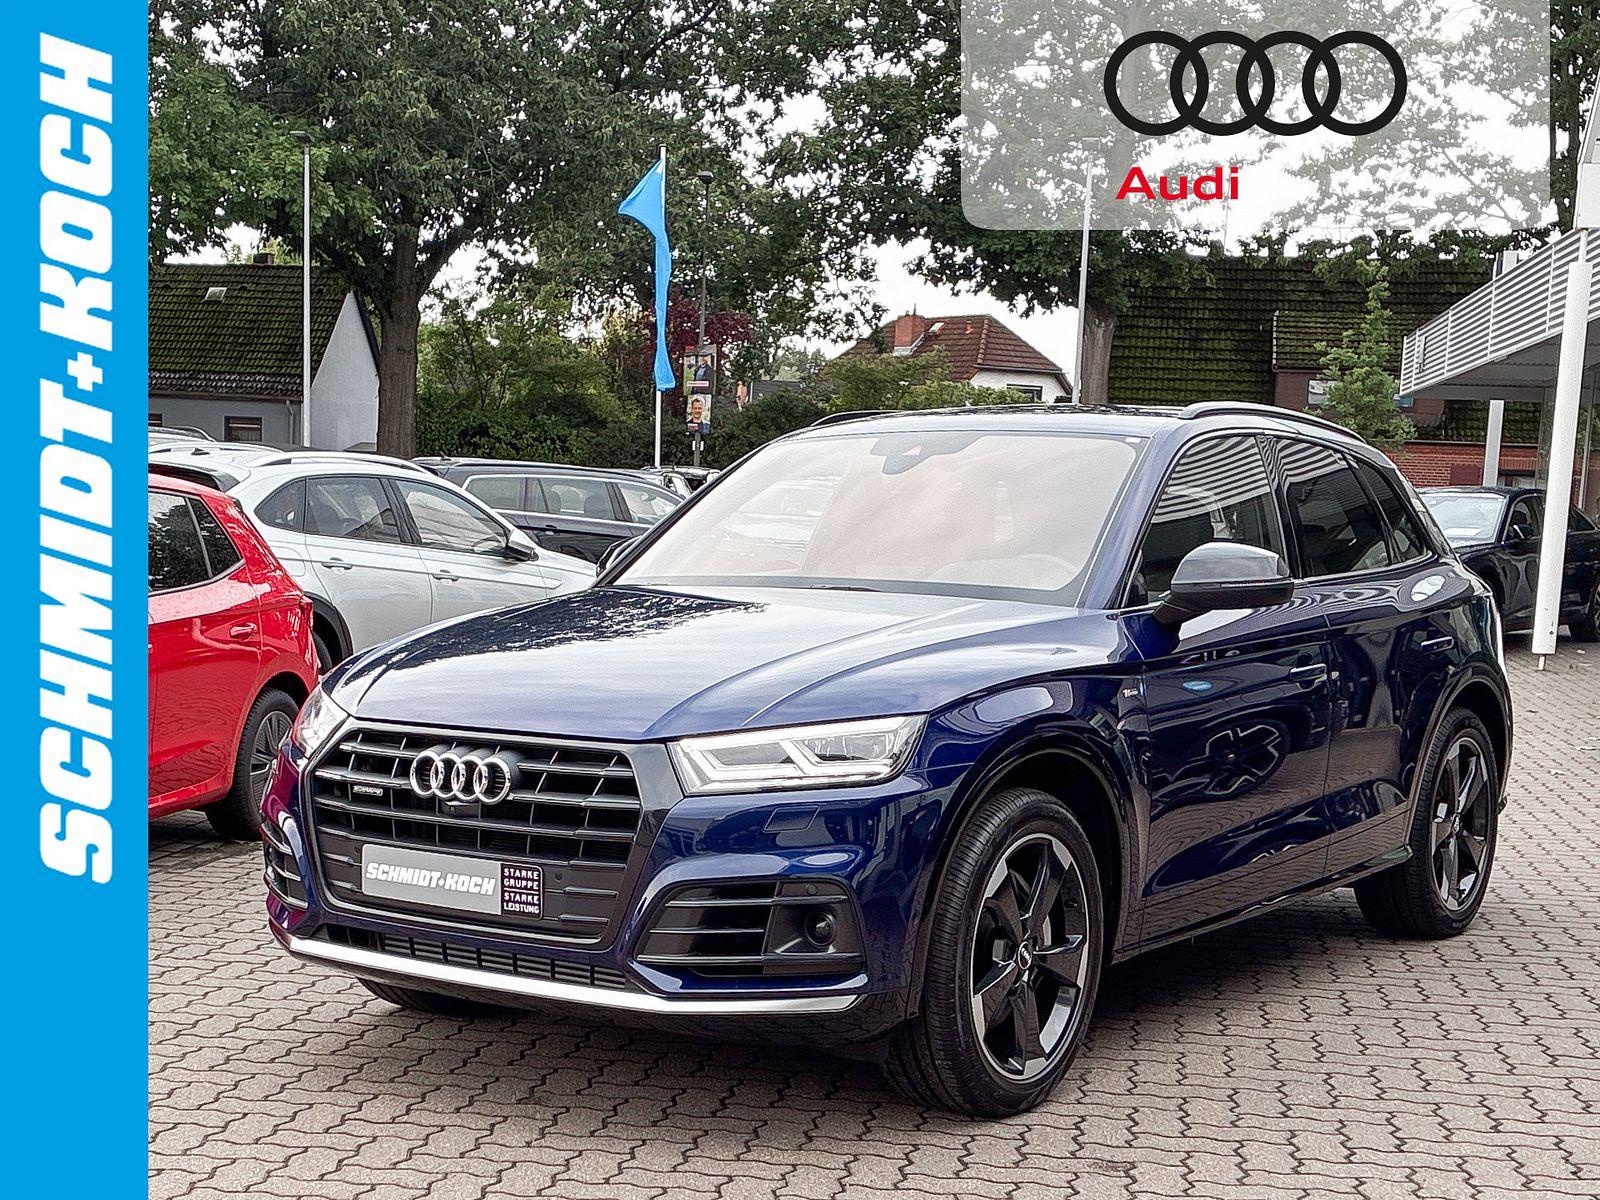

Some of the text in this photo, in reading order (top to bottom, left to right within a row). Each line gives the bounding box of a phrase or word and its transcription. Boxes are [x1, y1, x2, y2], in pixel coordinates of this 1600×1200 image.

[365, 862, 496, 896] SCHMIDT+KOCH
[503, 868, 540, 880] STARKE
[503, 878, 540, 890] GRUPPE
[503, 892, 540, 904] STARKE
[503, 902, 541, 914] LEISTUNG
